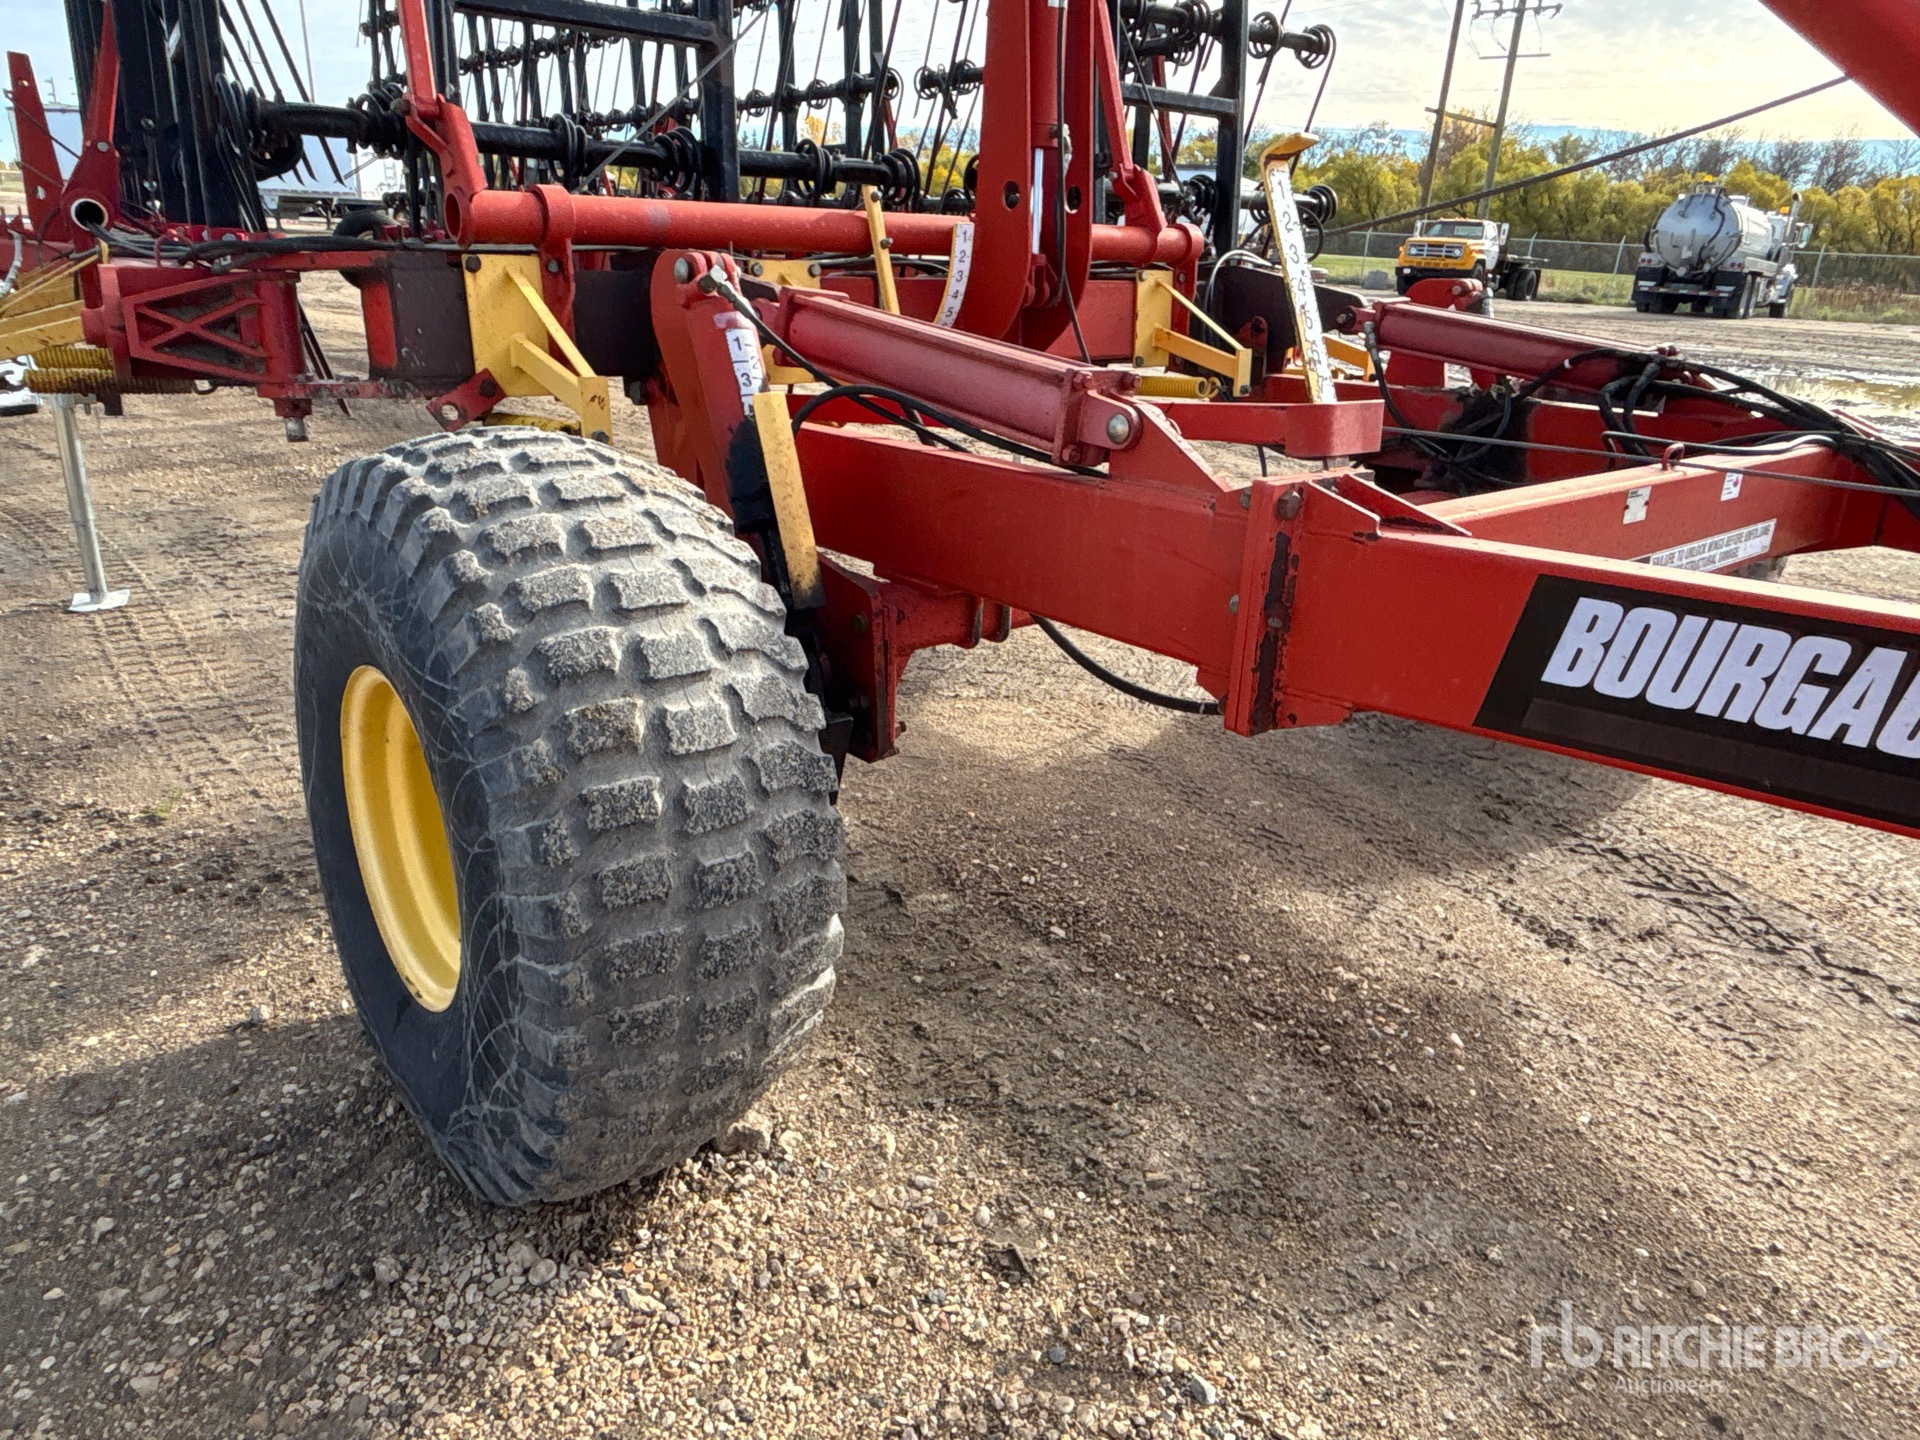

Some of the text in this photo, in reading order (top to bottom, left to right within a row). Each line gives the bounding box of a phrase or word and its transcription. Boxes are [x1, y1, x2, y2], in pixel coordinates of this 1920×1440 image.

[1282, 211, 1293, 233] 2
[961, 230, 969, 243] 1
[958, 249, 967, 263] 2
[1289, 243, 1300, 264] 3
[956, 270, 964, 282] 3
[951, 289, 960, 300] 4
[945, 306, 954, 318] 5
[733, 336, 742, 351] 1
[750, 355, 761, 370] 2
[740, 372, 753, 388] 3
